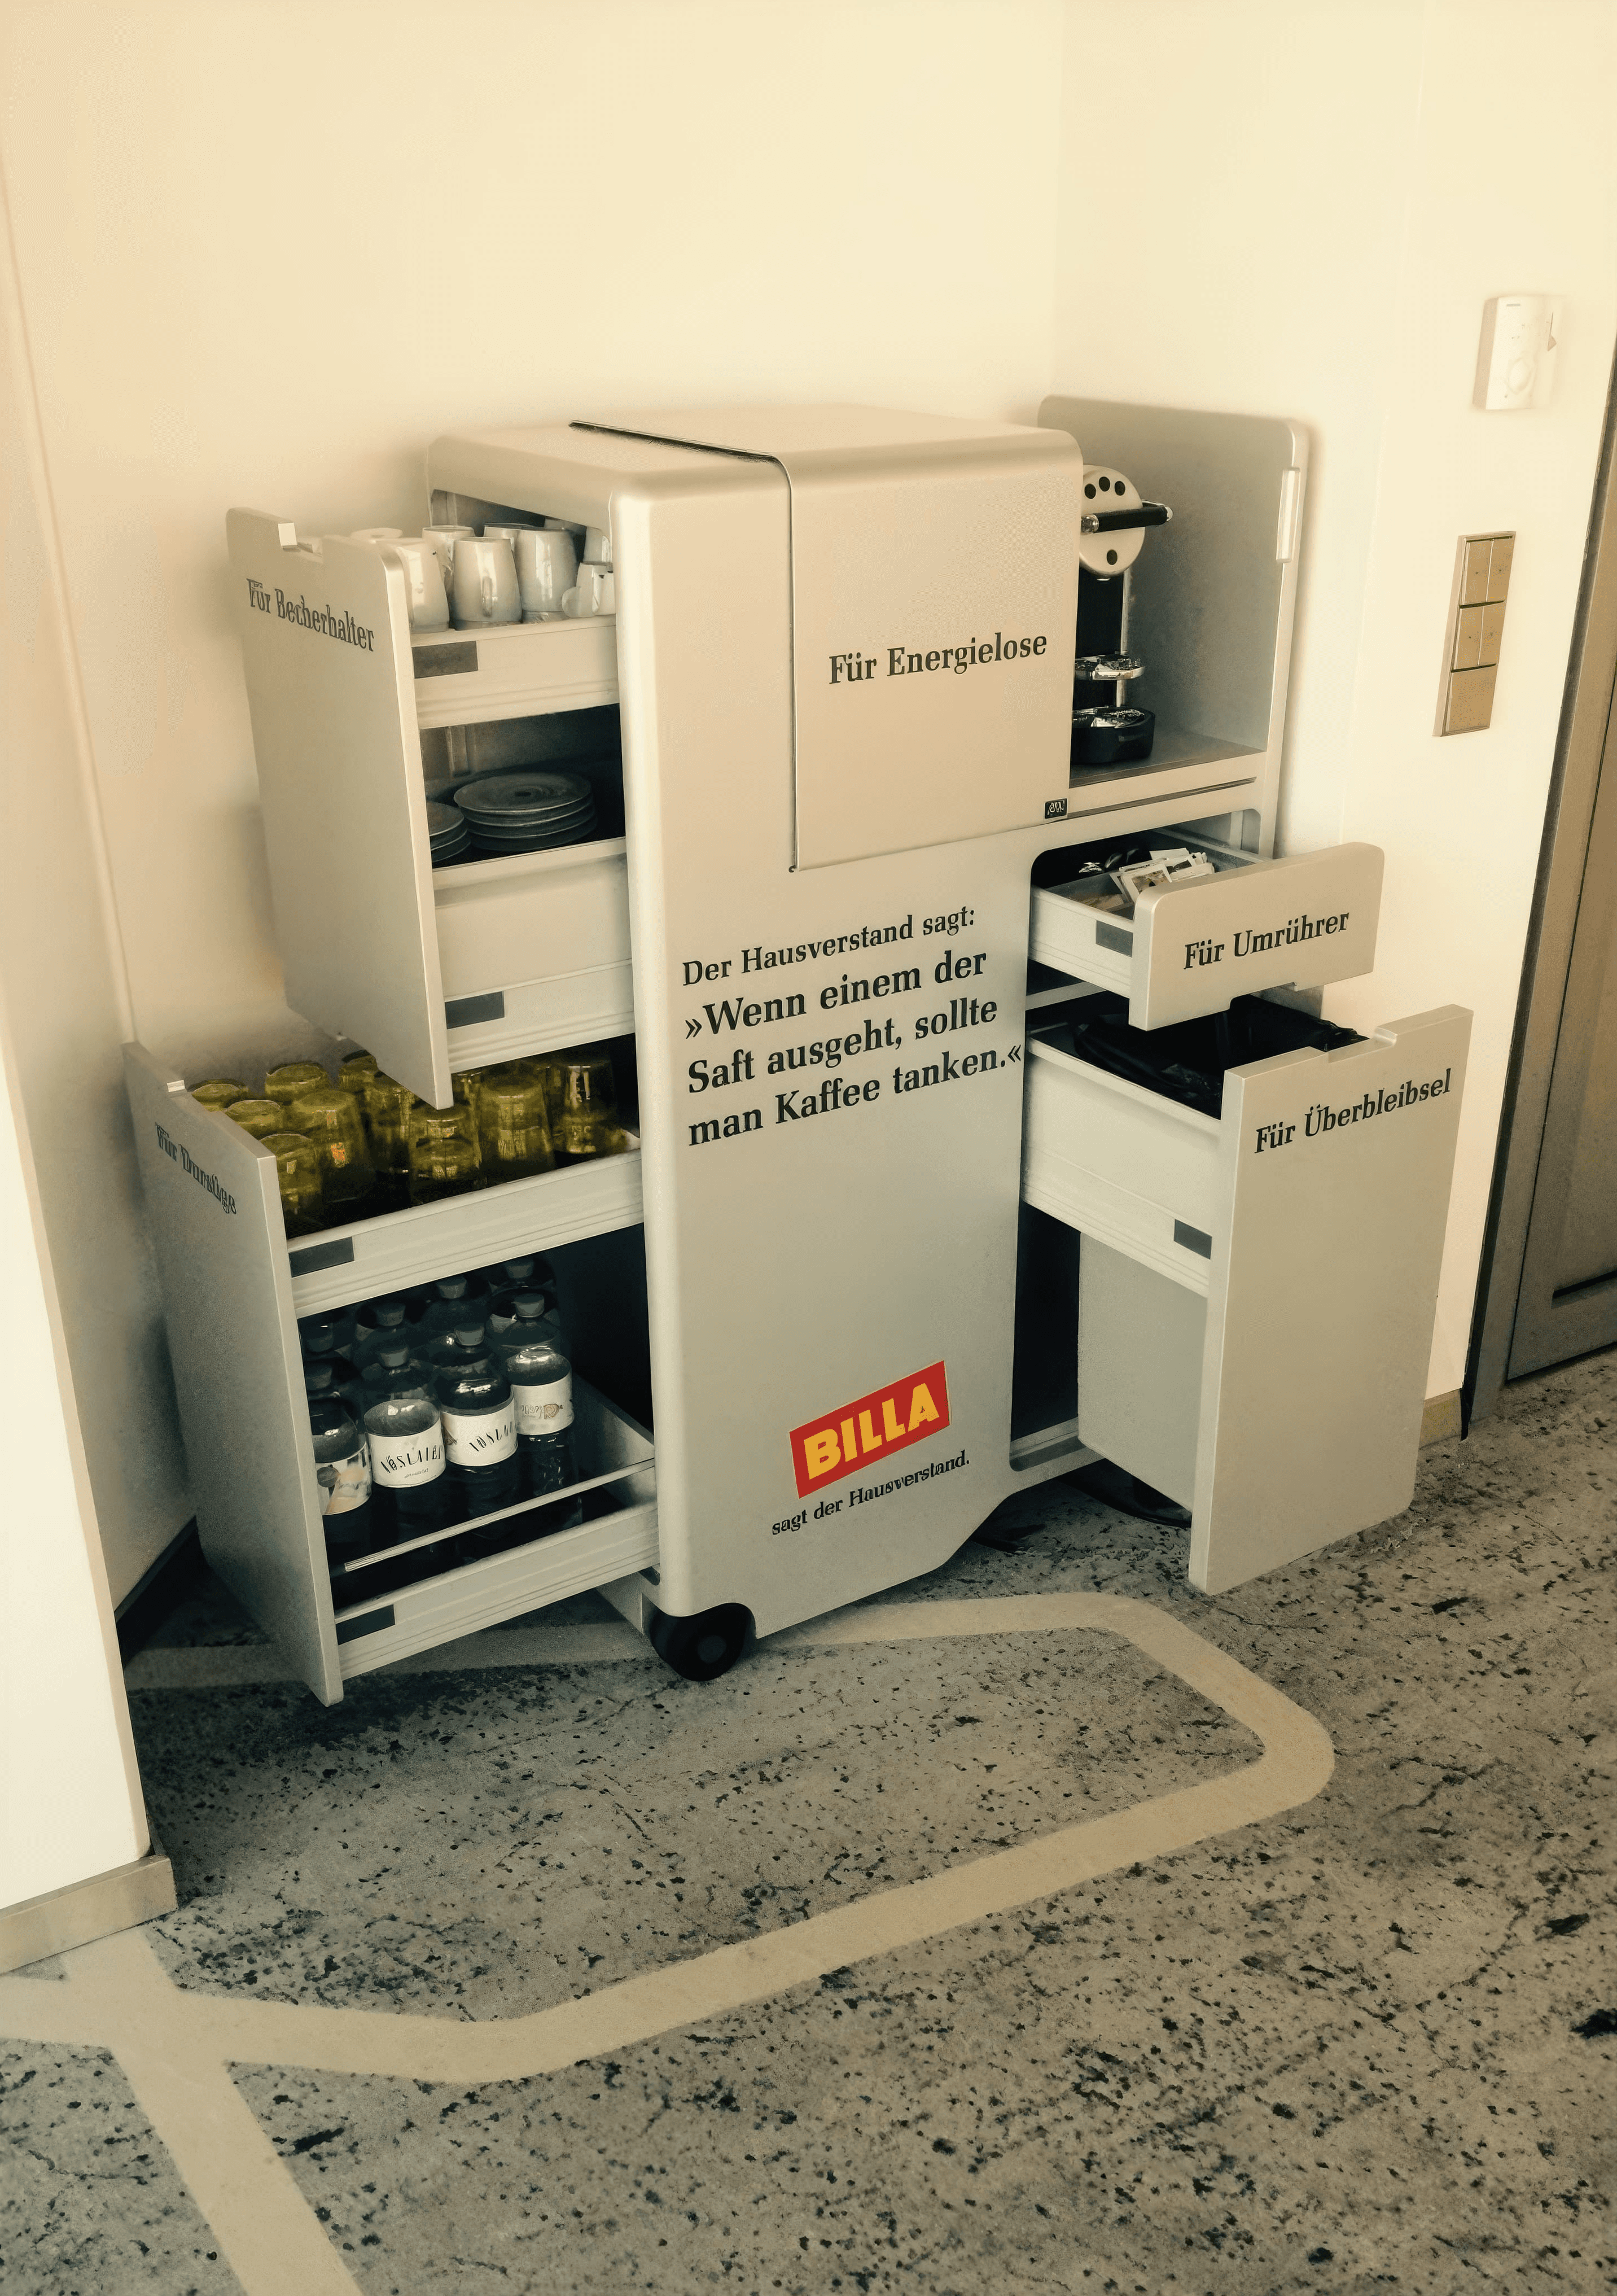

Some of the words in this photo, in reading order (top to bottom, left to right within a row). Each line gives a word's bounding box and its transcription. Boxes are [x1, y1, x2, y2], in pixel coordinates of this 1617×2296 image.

[246, 578, 271, 614] Für
[274, 588, 374, 651] Becherhalter
[829, 651, 877, 684] Für
[887, 632, 1047, 676] Energielose
[682, 960, 731, 986] Der
[740, 914, 913, 974] Hausverstand
[922, 906, 975, 937] sagt:
[1183, 938, 1224, 970] Für
[1233, 912, 1349, 957] Umrührer
[685, 991, 807, 1039] »Wenn
[820, 966, 922, 1010] einem
[934, 949, 987, 984] der
[687, 1048, 755, 1094] Saft
[766, 1017, 902, 1074] ausgeht,
[914, 997, 997, 1040] sollte
[688, 1107, 764, 1147] man
[774, 1077, 880, 1124] Kaffee
[892, 1044, 1022, 1094] tanken.«
[1254, 1121, 1296, 1154] Für
[1304, 1068, 1452, 1137] Überbleibsel
[804, 1383, 940, 1480] BILLA
[772, 1509, 808, 1535] sagt
[813, 1499, 843, 1519] der
[848, 1449, 970, 1507] Hausverstand.
